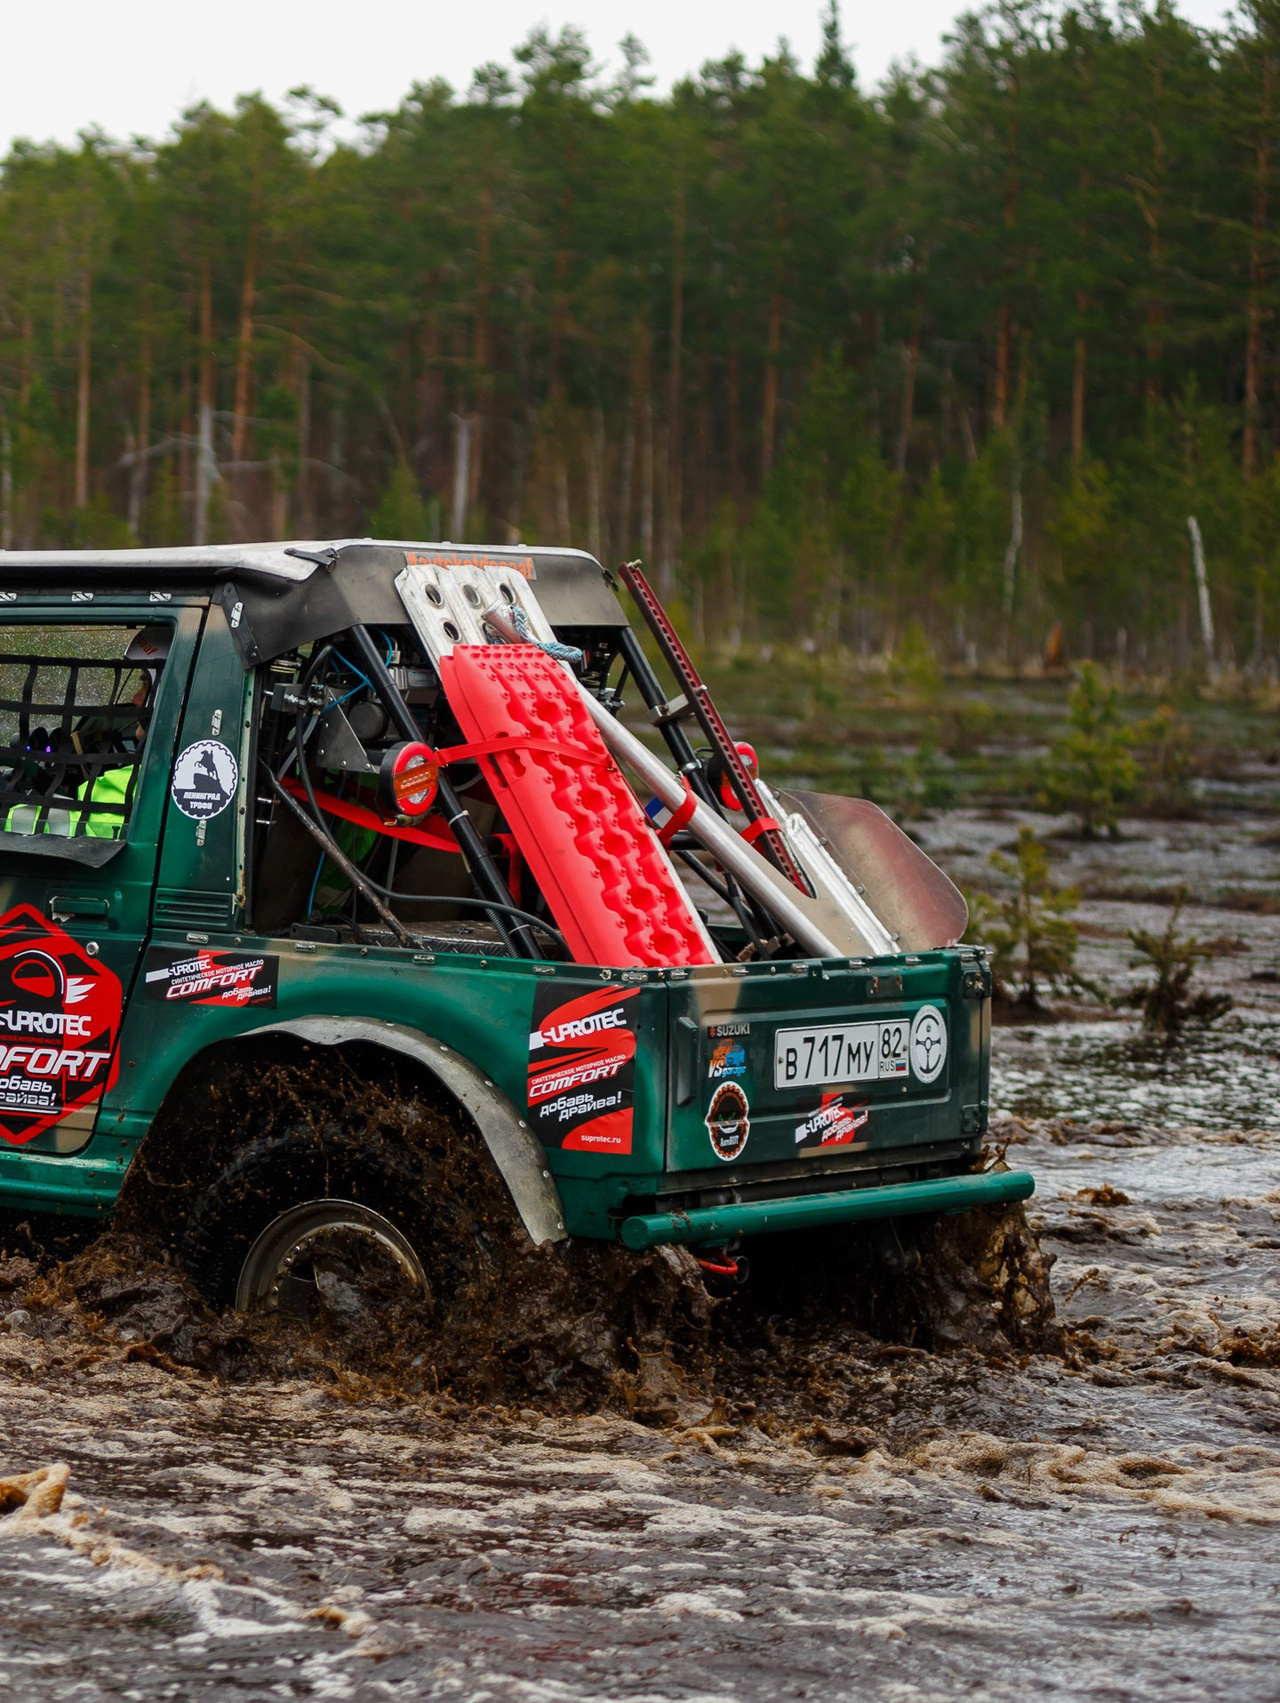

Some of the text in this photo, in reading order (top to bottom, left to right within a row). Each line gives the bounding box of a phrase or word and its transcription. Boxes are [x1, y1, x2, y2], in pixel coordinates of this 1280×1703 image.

[183, 791, 221, 800] ЛЕНИНГРАД
[189, 801, 213, 810] ТРОФИ
[160, 959, 211, 979] SUPROTEC
[166, 966, 263, 997] COMFORT
[538, 1008, 627, 1045] SUPROTEC
[716, 1023, 751, 1037] SUZUKI
[881, 1027, 903, 1058] 82
[529, 1061, 624, 1097] COMFORT
[880, 1061, 895, 1072] RUS
[540, 1093, 594, 1118] добавь
[558, 1091, 622, 1122] драйва!
[801, 1103, 845, 1136] SUPROTEC
[581, 1134, 621, 1143] suprotec.ru
